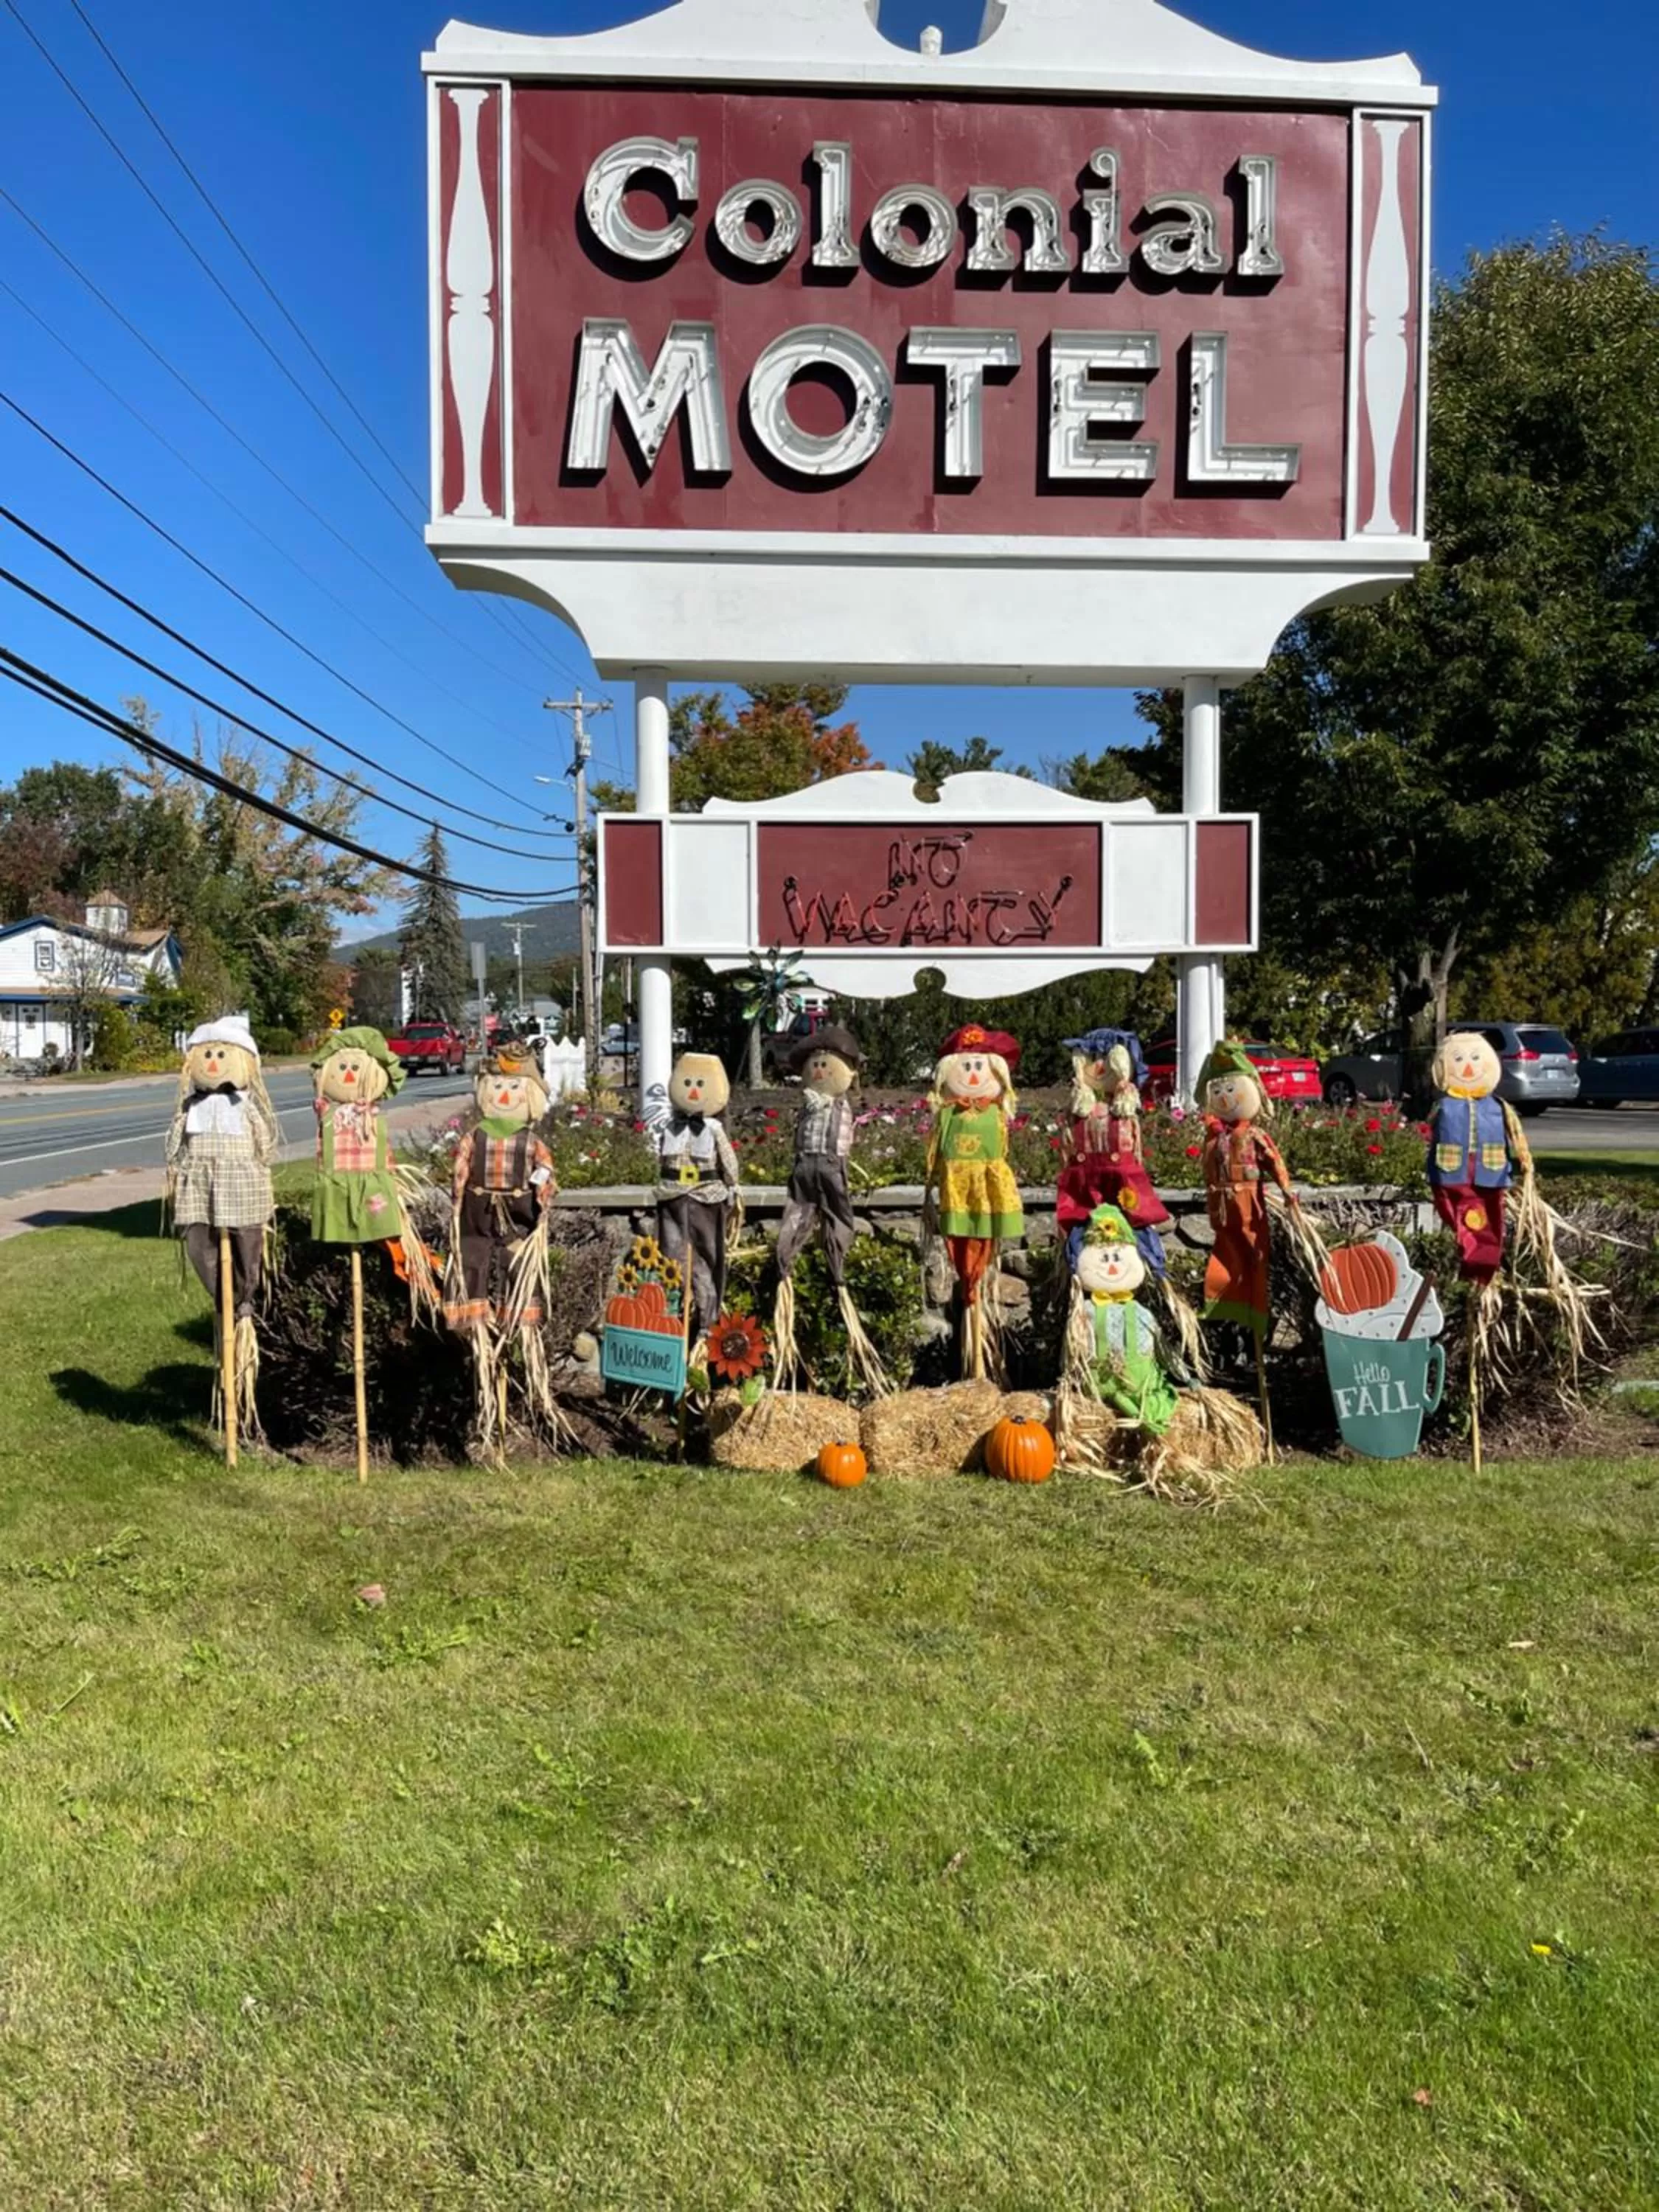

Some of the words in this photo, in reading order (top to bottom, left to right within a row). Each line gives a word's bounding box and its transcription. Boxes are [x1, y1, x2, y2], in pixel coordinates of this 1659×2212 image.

[582, 136, 1284, 276] Colonial
[566, 319, 1301, 481] MOTEL
[888, 835, 972, 887] NO
[784, 882, 1069, 945] VACANCY
[611, 1342, 672, 1372] Welcome
[1354, 1361, 1390, 1385] Hello
[1335, 1381, 1419, 1418] FALL
